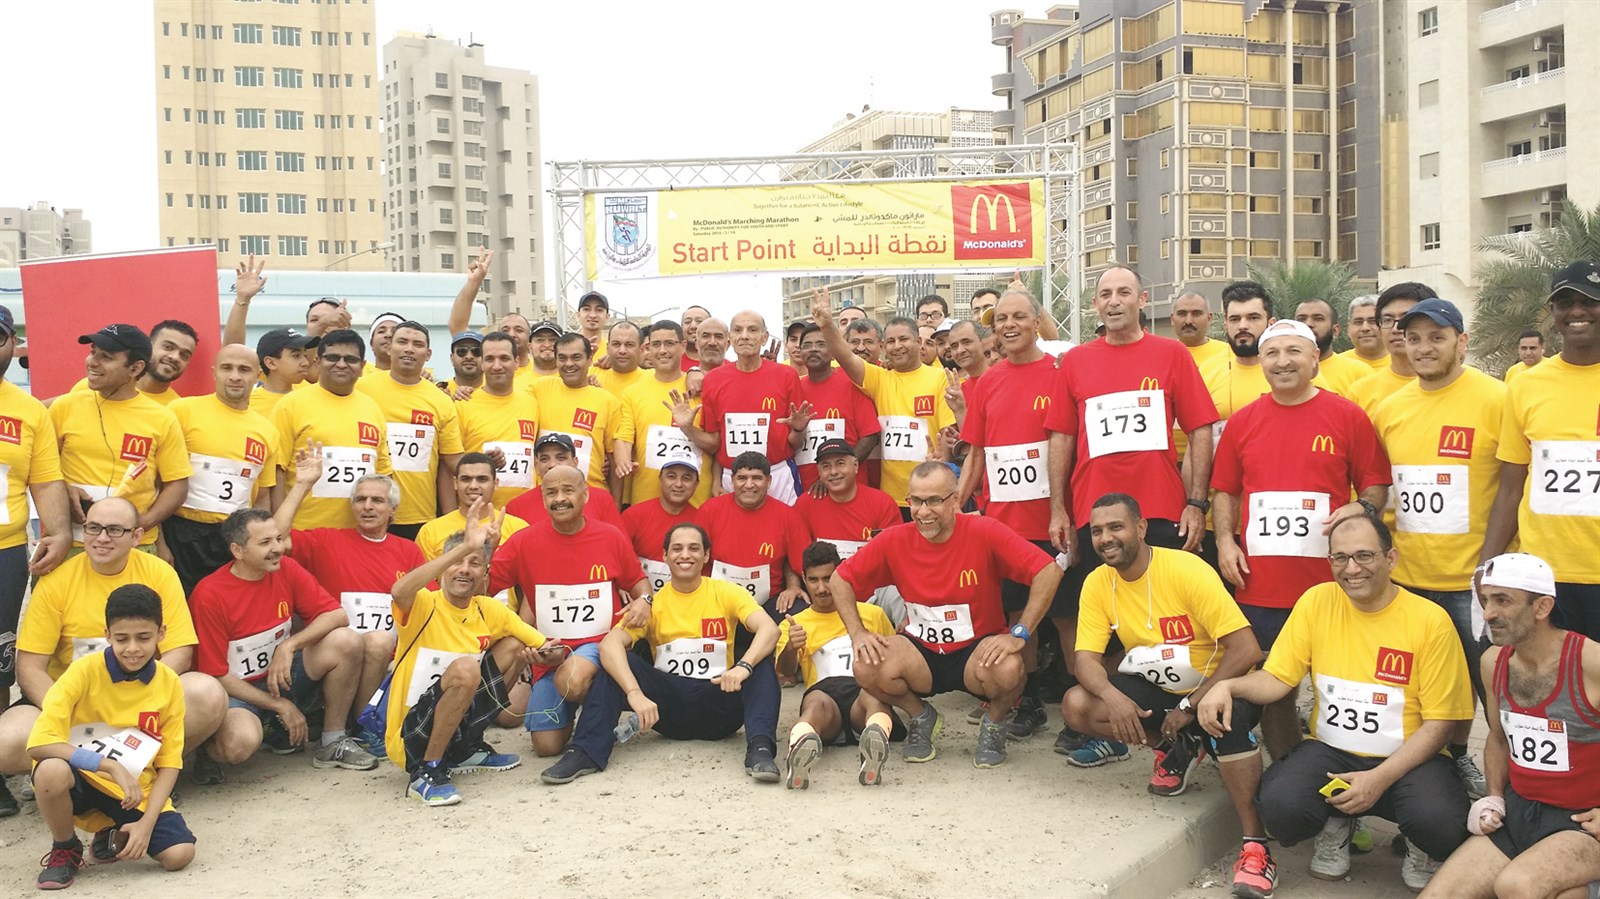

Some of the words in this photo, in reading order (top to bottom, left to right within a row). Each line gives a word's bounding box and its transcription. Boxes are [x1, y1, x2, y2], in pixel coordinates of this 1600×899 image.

[840, 200, 864, 208] Lifestyle
[672, 242, 729, 264] Start
[737, 238, 796, 261] Point
[813, 234, 879, 261] البداية
[888, 233, 947, 254] نقطة
[963, 239, 1025, 249] McDonald's
[1100, 413, 1147, 437] 173
[729, 430, 763, 445] 111
[885, 432, 914, 448] 271
[327, 466, 366, 483] 257
[997, 465, 1037, 485] 200
[1544, 469, 1600, 494] 227
[219, 481, 233, 500] 3
[1400, 491, 1444, 514] 300
[1259, 516, 1309, 537] 193
[356, 612, 394, 631] 179
[552, 605, 595, 623] 172
[917, 623, 955, 644] 188
[667, 658, 709, 677] 209
[1326, 704, 1379, 734] 235
[1508, 734, 1558, 765] 182
